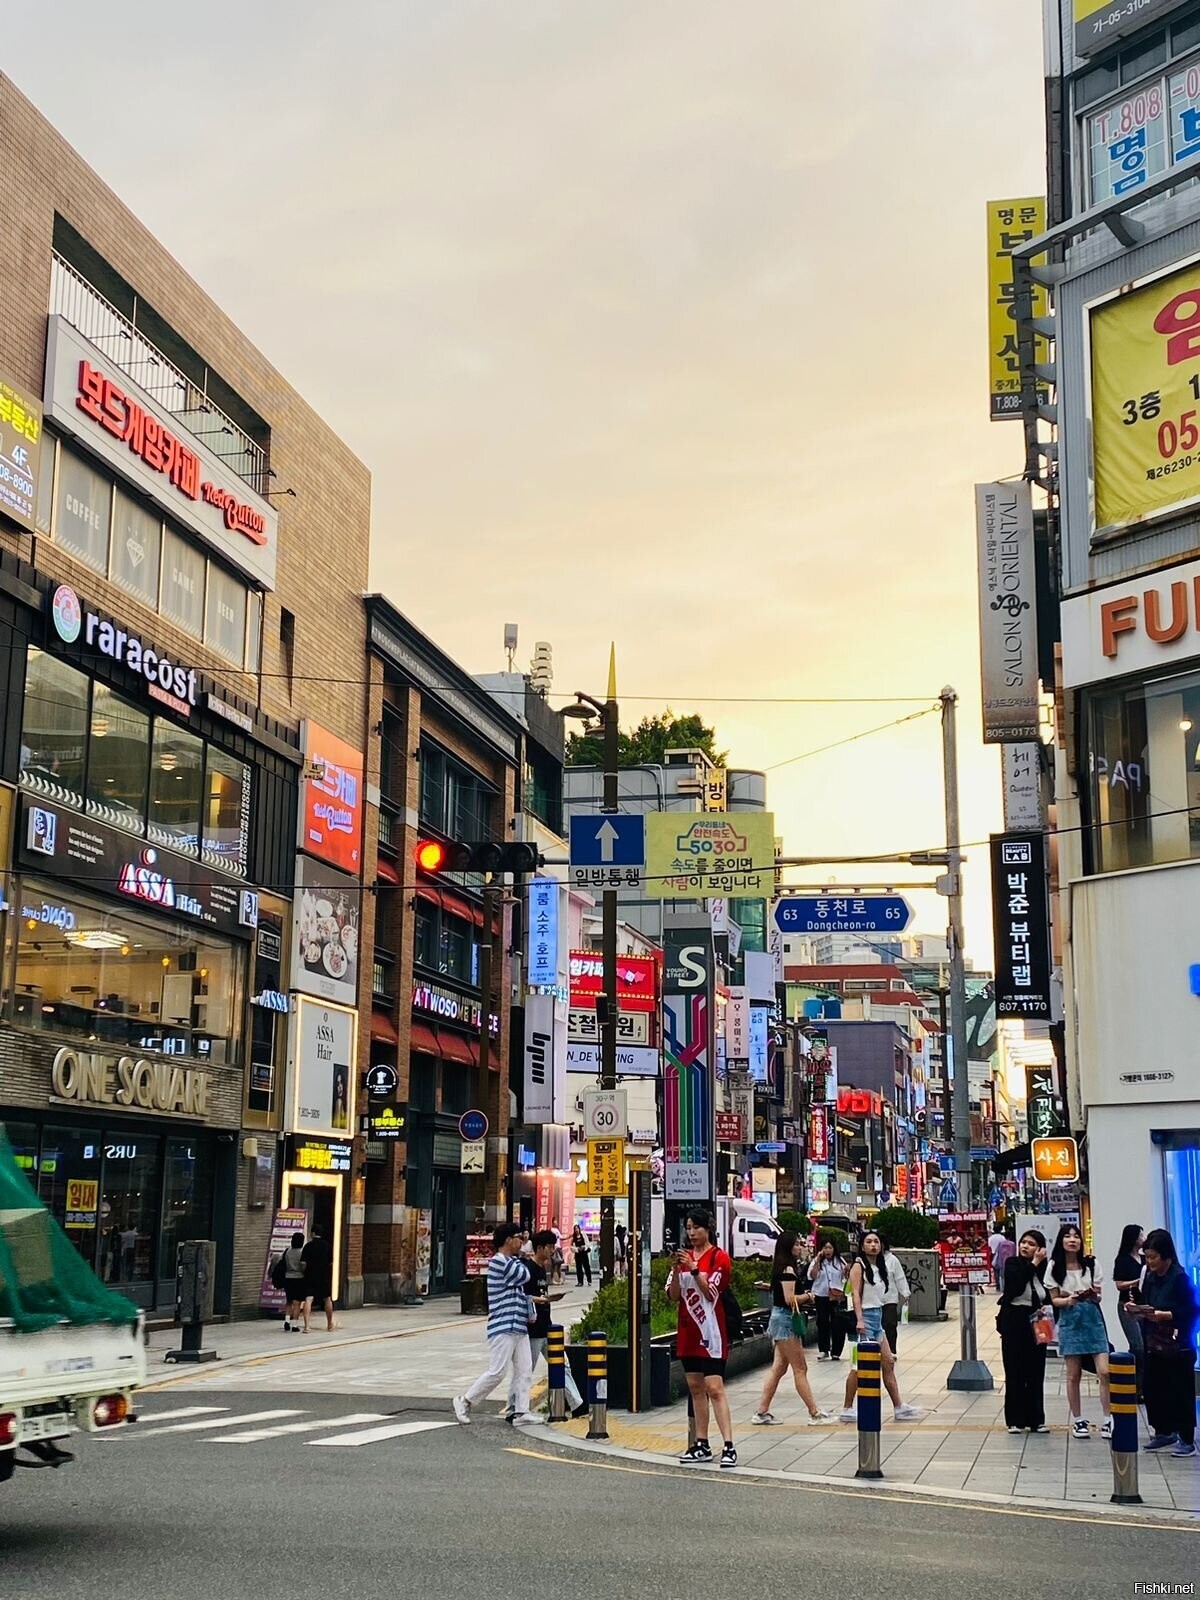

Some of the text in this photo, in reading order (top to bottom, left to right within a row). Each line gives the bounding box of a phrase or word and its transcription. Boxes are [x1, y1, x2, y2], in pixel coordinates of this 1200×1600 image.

[997, 207, 1038, 226] 명문
[1122, 389, 1161, 426] 3층
[76, 359, 201, 502] 보드게임카페
[11, 445, 29, 467] 4F
[65, 493, 101, 531] COFFEE
[222, 494, 268, 546] Button
[999, 493, 1024, 689] SALON ORIENTAL
[1100, 576, 1200, 658] FU
[85, 611, 197, 706] raracost
[985, 725, 1037, 738] 805-0173
[693, 828, 731, 839] 안전속도
[690, 840, 736, 855] 5030
[1005, 852, 1028, 861] LAB
[670, 857, 754, 873] 속도를 줄이면
[118, 862, 176, 908] ASSA
[575, 868, 641, 887] 일방통행
[660, 875, 762, 892] 사람이 보입니다
[536, 892, 549, 906] 룸
[1007, 872, 1031, 915] 박준
[783, 909, 798, 921] 63
[814, 899, 867, 919] 동천로
[885, 908, 900, 919] 65
[536, 910, 550, 937] 소주
[806, 920, 876, 932] Dongcheon-ro
[535, 942, 549, 969] 호프
[1008, 921, 1032, 987] 뷰티랩
[666, 966, 689, 974] YOUNG
[678, 946, 707, 988] S
[423, 986, 469, 1023] TWOSOME
[470, 1005, 499, 1033] PLCE
[998, 1001, 1047, 1012] 807.1170
[316, 1026, 335, 1044] ASSA
[316, 1043, 333, 1061] Hair
[52, 1047, 117, 1104] ONE
[116, 1056, 214, 1118] SQUARE
[597, 1112, 614, 1126] 30
[1035, 1148, 1070, 1167] 사진
[69, 1183, 96, 1209] 임대
